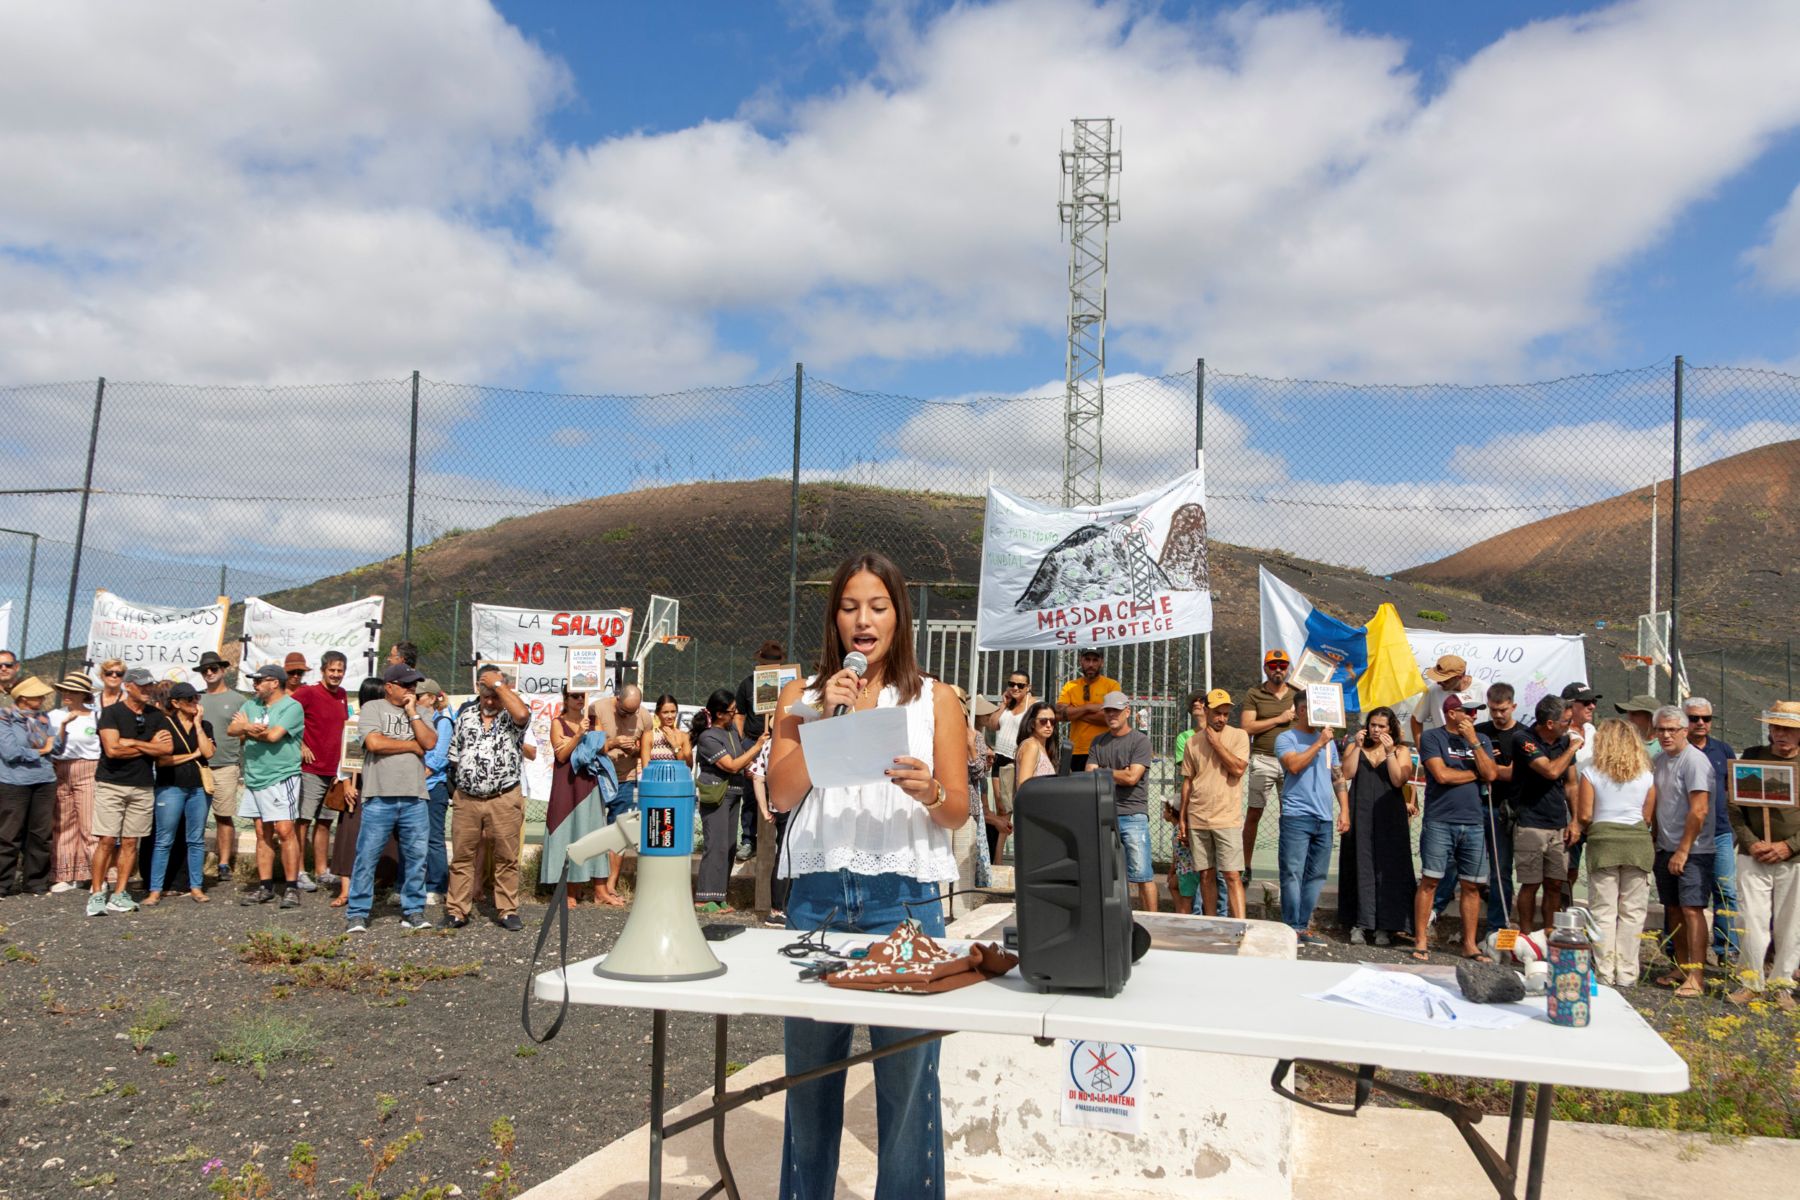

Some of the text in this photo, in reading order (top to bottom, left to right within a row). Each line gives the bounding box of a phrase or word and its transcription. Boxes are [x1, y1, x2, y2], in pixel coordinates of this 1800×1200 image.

[96, 600, 114, 618] NO
[1037, 595, 1173, 631] MASDACHE
[518, 612, 625, 637] LA SALUD
[1055, 617, 1174, 646] SE PROTEGE
[278, 628, 297, 647] SE
[104, 642, 200, 664] NUESTRAS
[514, 641, 545, 665] NO
[1493, 645, 1525, 664] NO
[1069, 1089, 1136, 1108] DI NO A LA ANTENA
